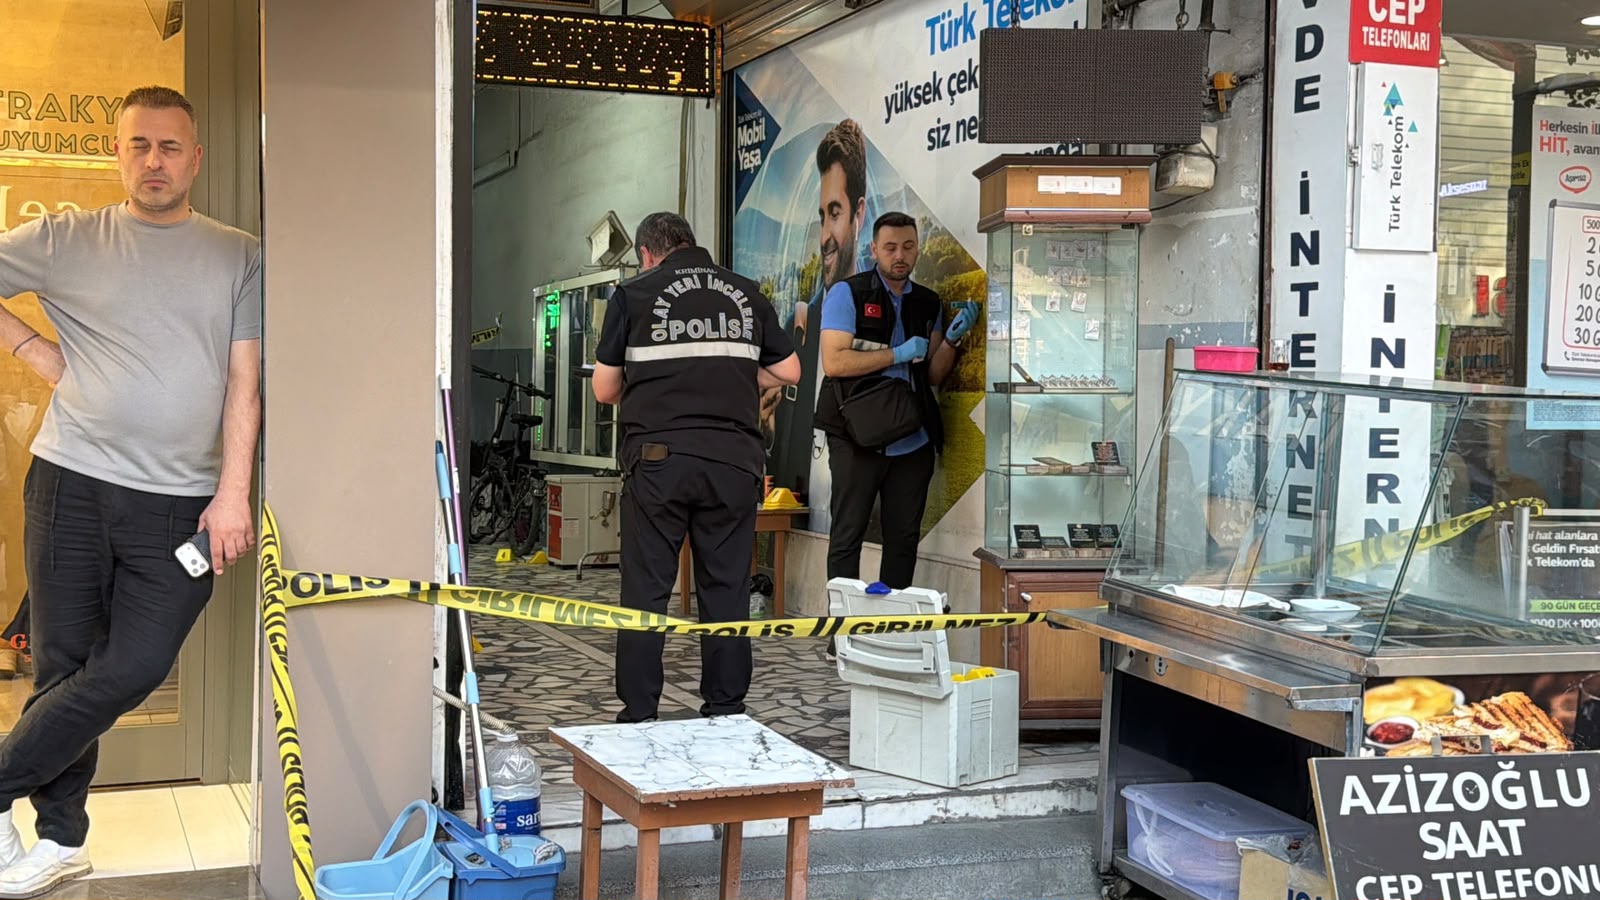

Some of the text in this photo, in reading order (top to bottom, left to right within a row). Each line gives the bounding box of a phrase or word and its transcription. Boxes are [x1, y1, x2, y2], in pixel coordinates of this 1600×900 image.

[1368, 0, 1426, 25] CEP
[925, 0, 1075, 56] Türk Teek
[1361, 26, 1431, 52] TELEFONLARI
[1293, 0, 1325, 114] DE
[0, 90, 124, 125] RAKY
[884, 71, 943, 125] yüksek
[737, 117, 767, 149] Mobil
[926, 115, 979, 152] siz ne
[1539, 120, 1589, 135] Herkesin
[1539, 133, 1570, 157] HİT,
[737, 148, 762, 174] Yaşa
[1388, 116, 1404, 233] Türk Telekom
[1578, 282, 1592, 301] 10
[651, 296, 672, 342] OLAY
[1575, 304, 1593, 322] 20
[668, 312, 742, 341] POLİS
[1573, 326, 1591, 345] 30
[1554, 530, 1598, 541] alanlara
[1532, 543, 1567, 555] Geldin
[1534, 556, 1596, 568] Telekom'da
[1540, 602, 1554, 611] 90
[1555, 600, 1577, 611] GÜN
[1339, 760, 1592, 816] AZİZOĞLU
[1418, 818, 1527, 861] SAAT
[1355, 873, 1424, 900] CEP
